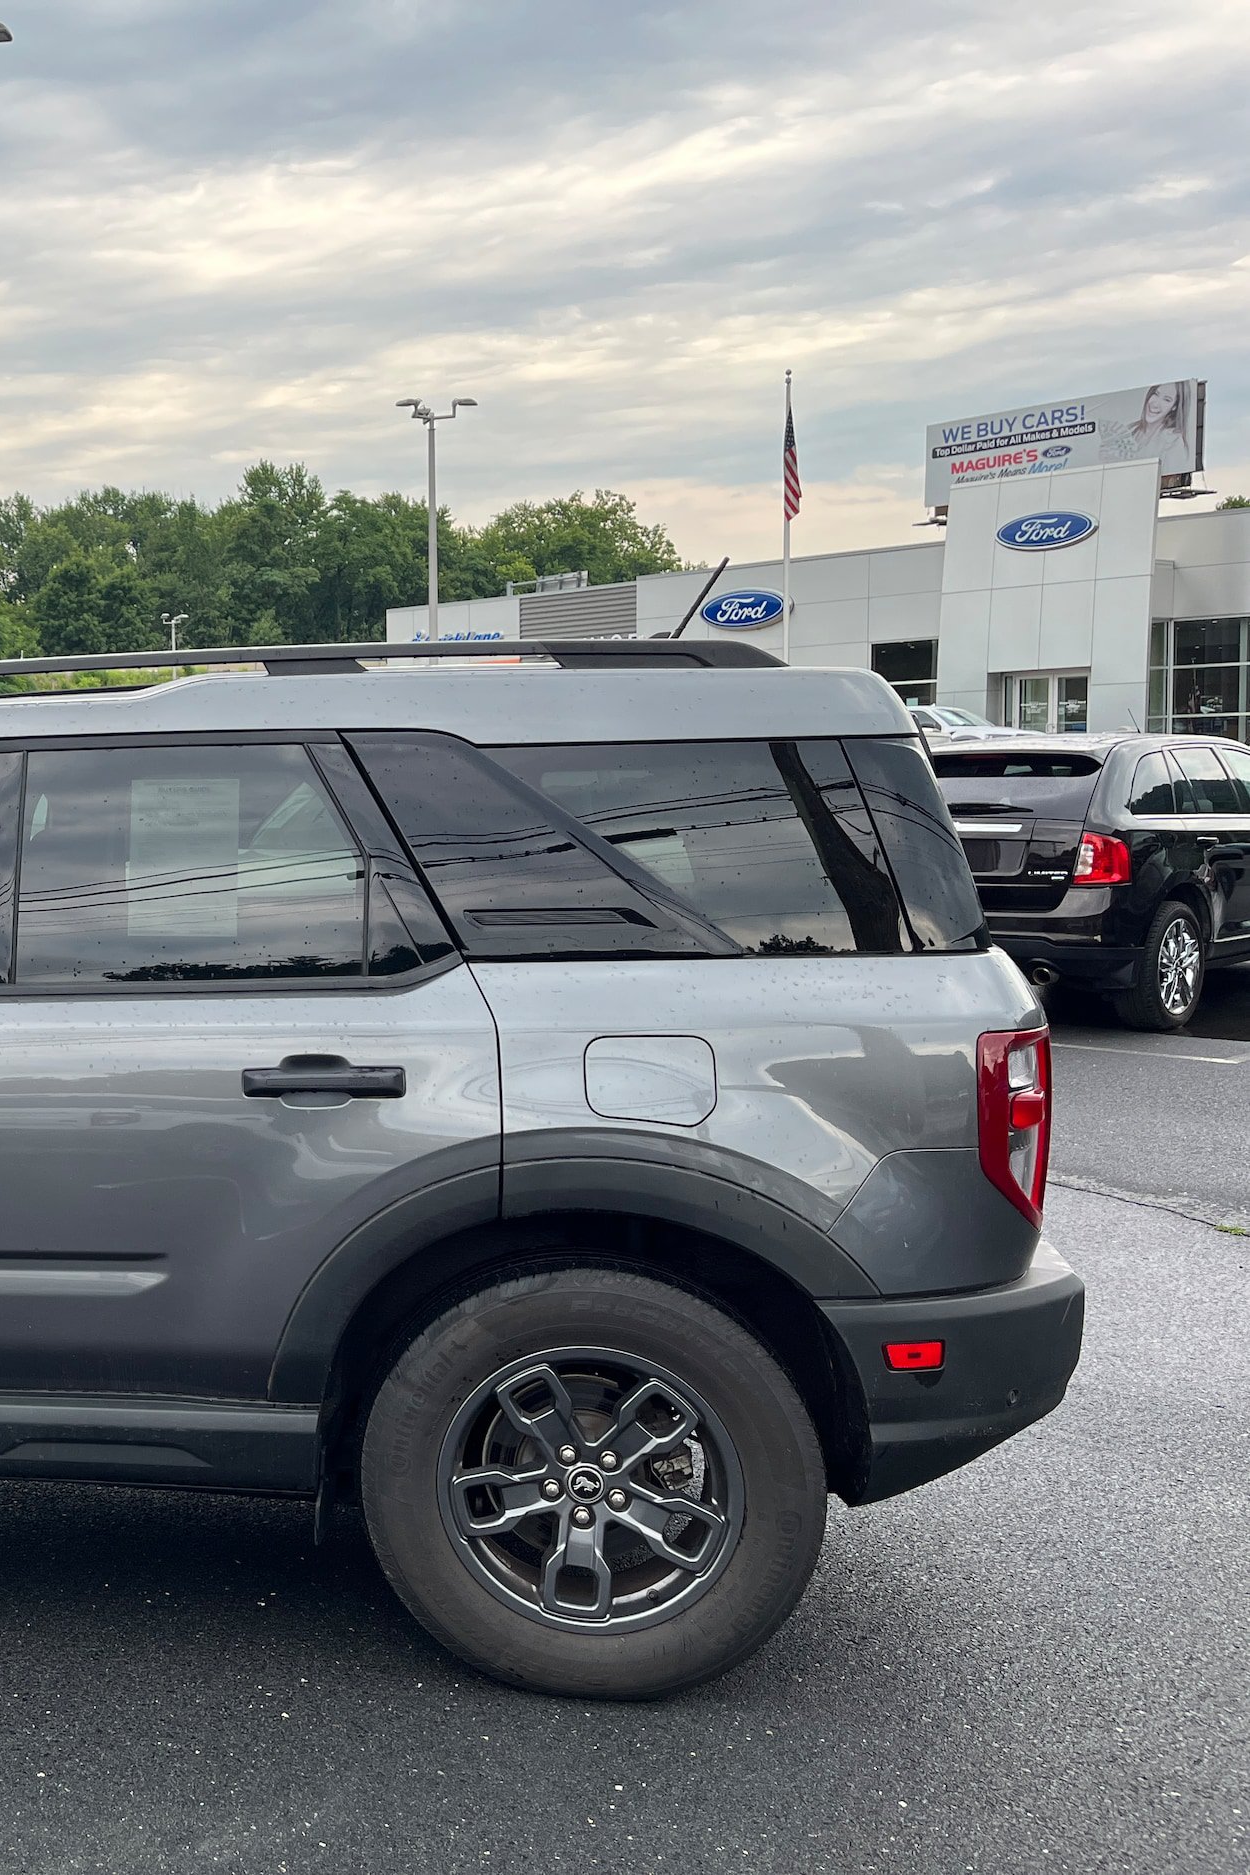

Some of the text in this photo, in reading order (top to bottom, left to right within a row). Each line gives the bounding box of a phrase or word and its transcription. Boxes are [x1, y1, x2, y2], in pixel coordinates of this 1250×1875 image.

[942, 404, 1085, 444] WE BUY CARS!
[935, 424, 1094, 458] Top Dollar Paid for All Makes & Models
[950, 449, 1038, 475] MAGUIRE'S
[997, 466, 1028, 479] Means
[1014, 517, 1072, 543] Ford
[716, 596, 768, 622] Ford
